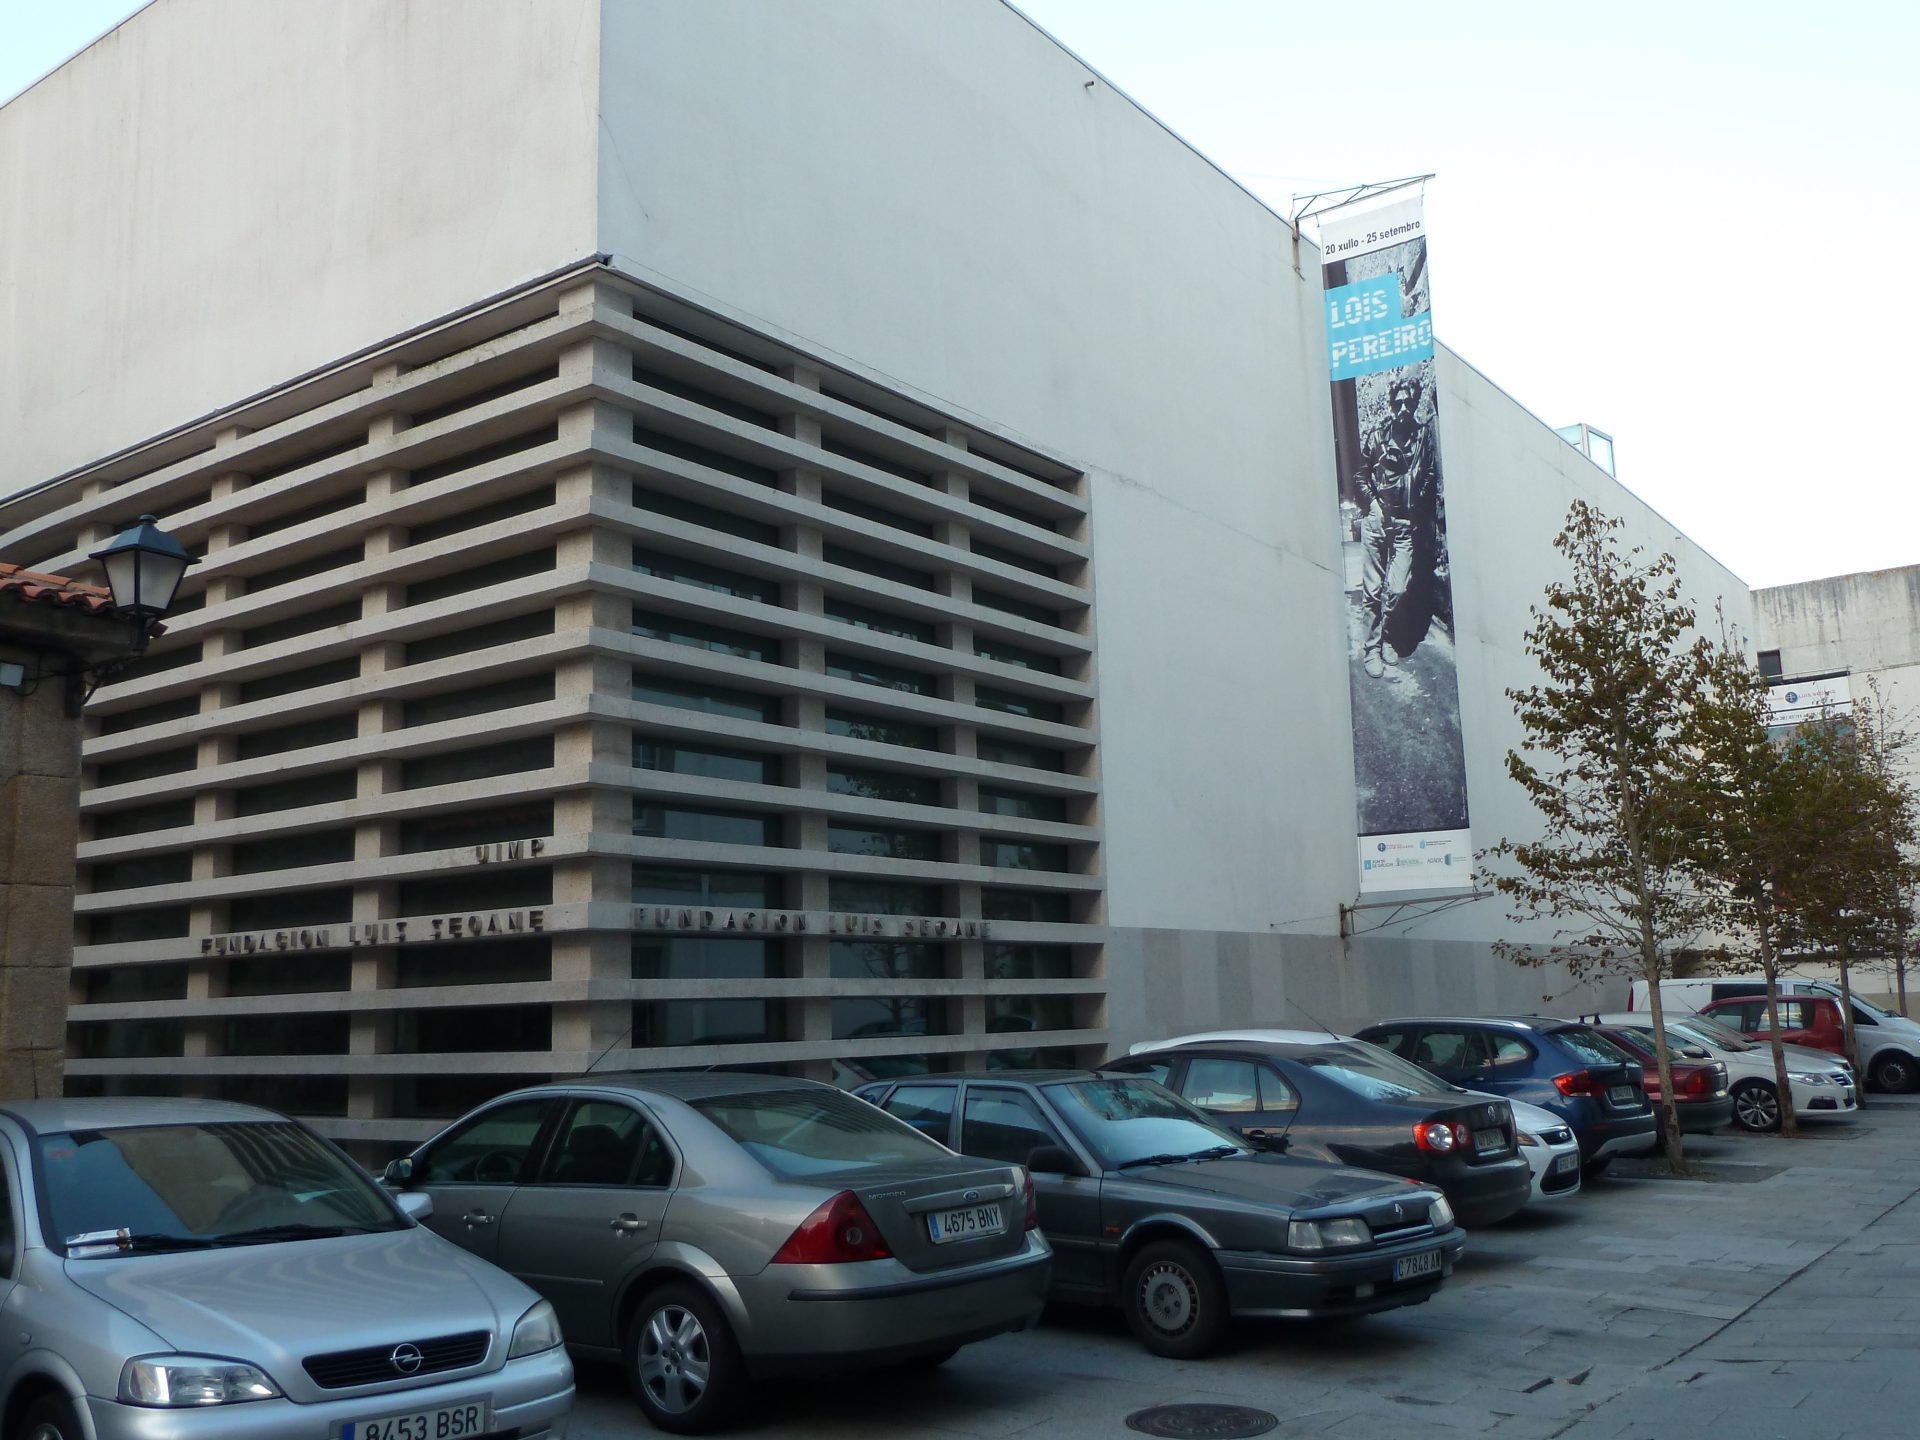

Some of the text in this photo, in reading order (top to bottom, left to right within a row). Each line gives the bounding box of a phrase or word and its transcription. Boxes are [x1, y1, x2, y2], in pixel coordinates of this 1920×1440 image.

[1325, 244, 1336, 255] 20
[1338, 239, 1359, 252] xullo
[1366, 232, 1377, 244] 25
[1379, 221, 1420, 240] setembro
[1330, 289, 1388, 329] LOIS
[1332, 319, 1432, 368] PEREIRO
[475, 838, 545, 864] UIMP
[349, 921, 407, 946] LUIS
[632, 907, 807, 932] FUNDACION
[829, 913, 886, 935] LUIS
[944, 1206, 999, 1234] 4675 BNY
[1406, 1255, 1429, 1275] 7848
[365, 1406, 479, 1440] 8453 BSR
